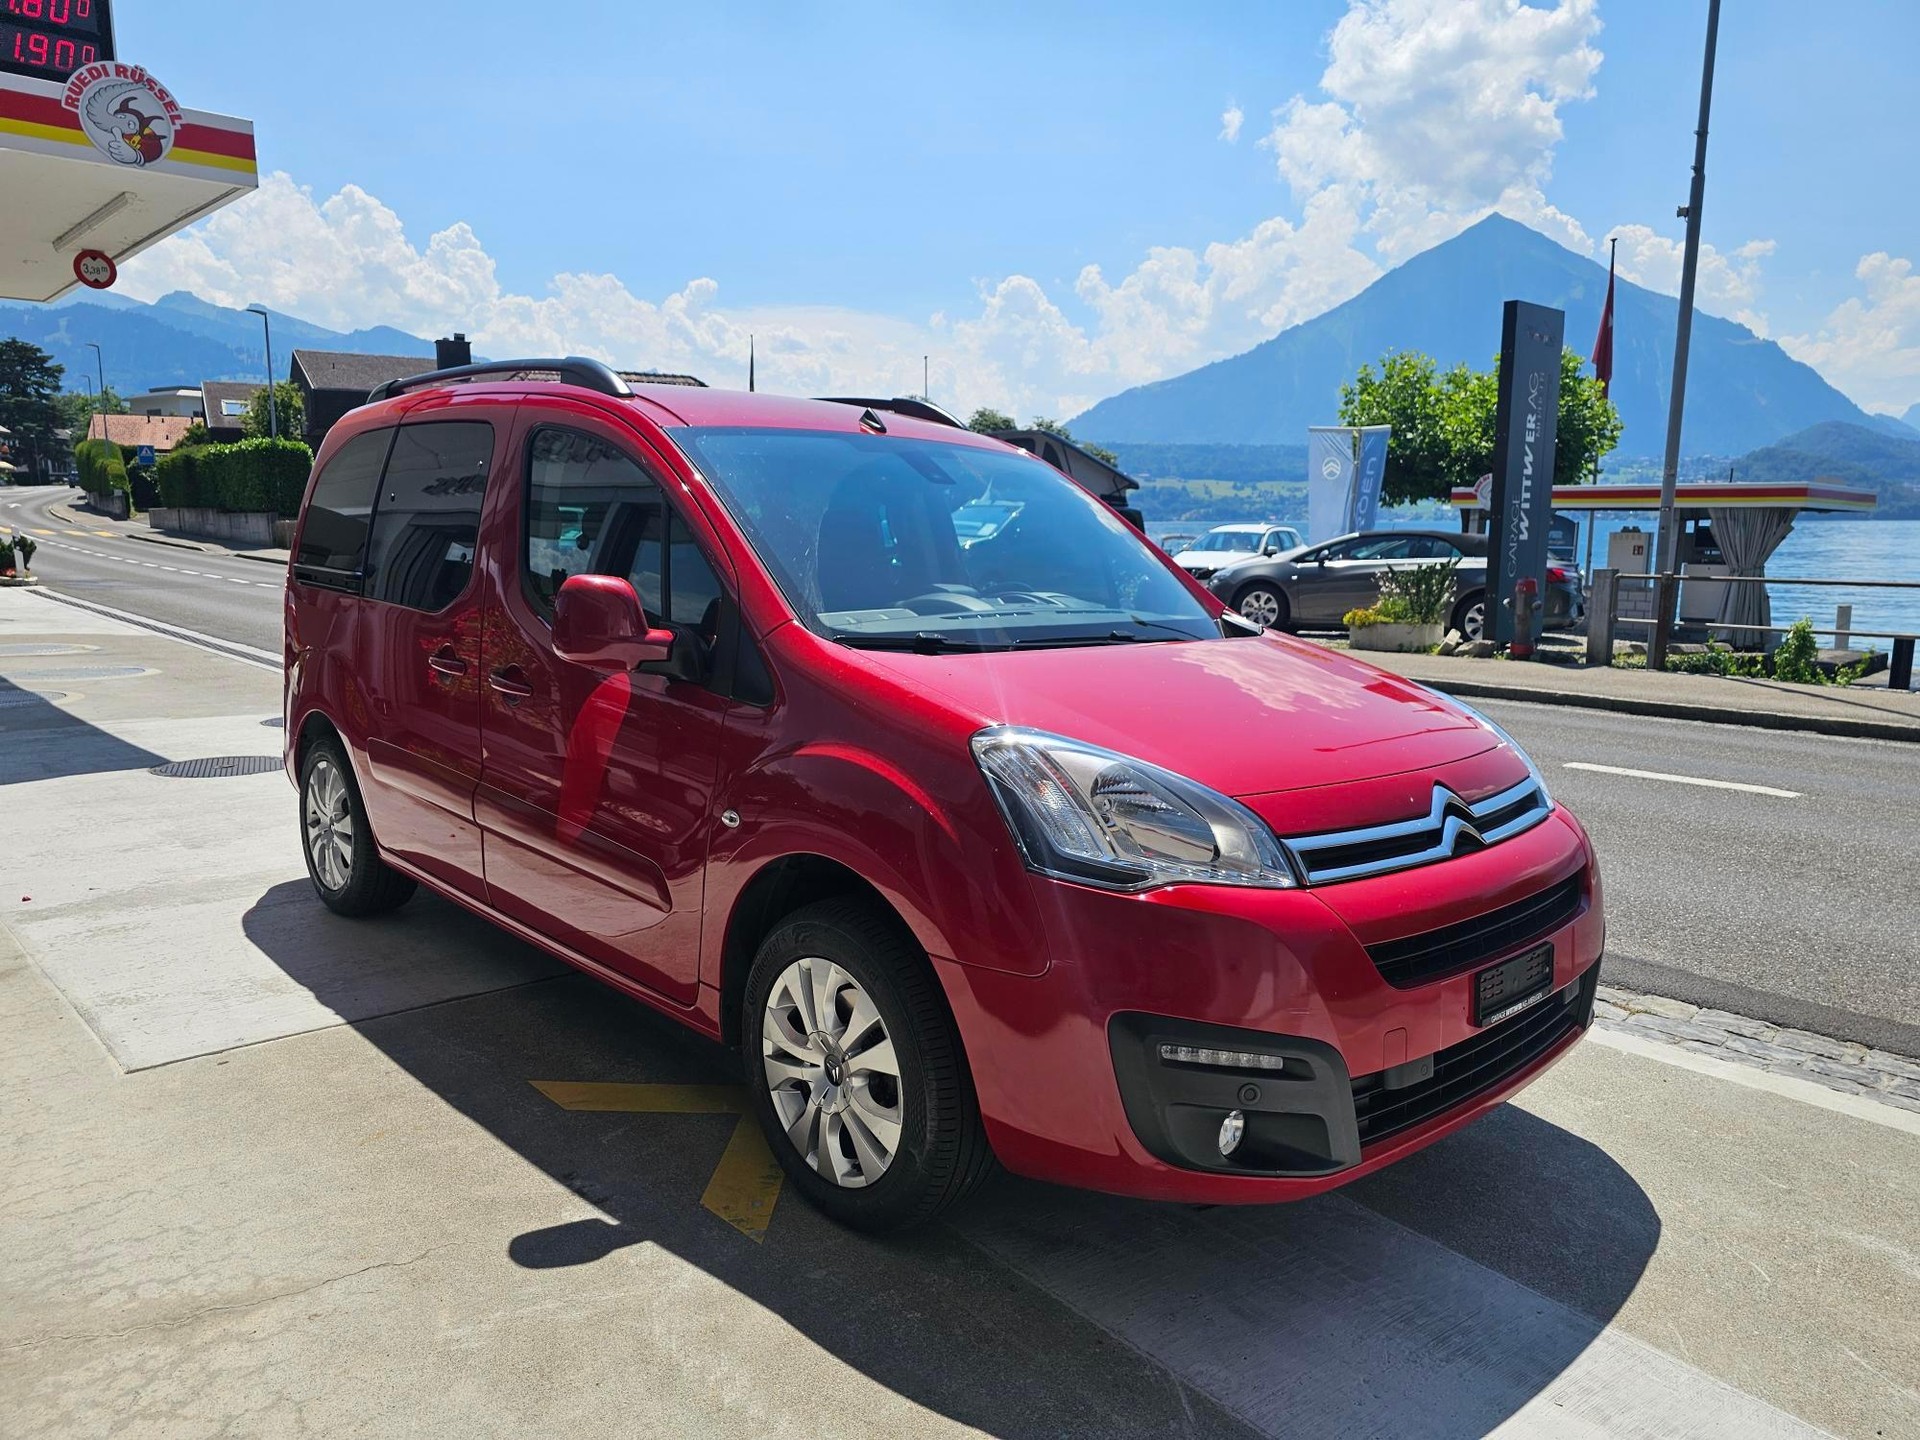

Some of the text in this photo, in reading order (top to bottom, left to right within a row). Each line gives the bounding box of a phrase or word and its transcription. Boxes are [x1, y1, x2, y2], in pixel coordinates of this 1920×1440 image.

[64, 63, 183, 126] RUEDI RÜSSEL
[1519, 371, 1539, 541] WITTWER AG
[1507, 494, 1521, 578] GARAGE
